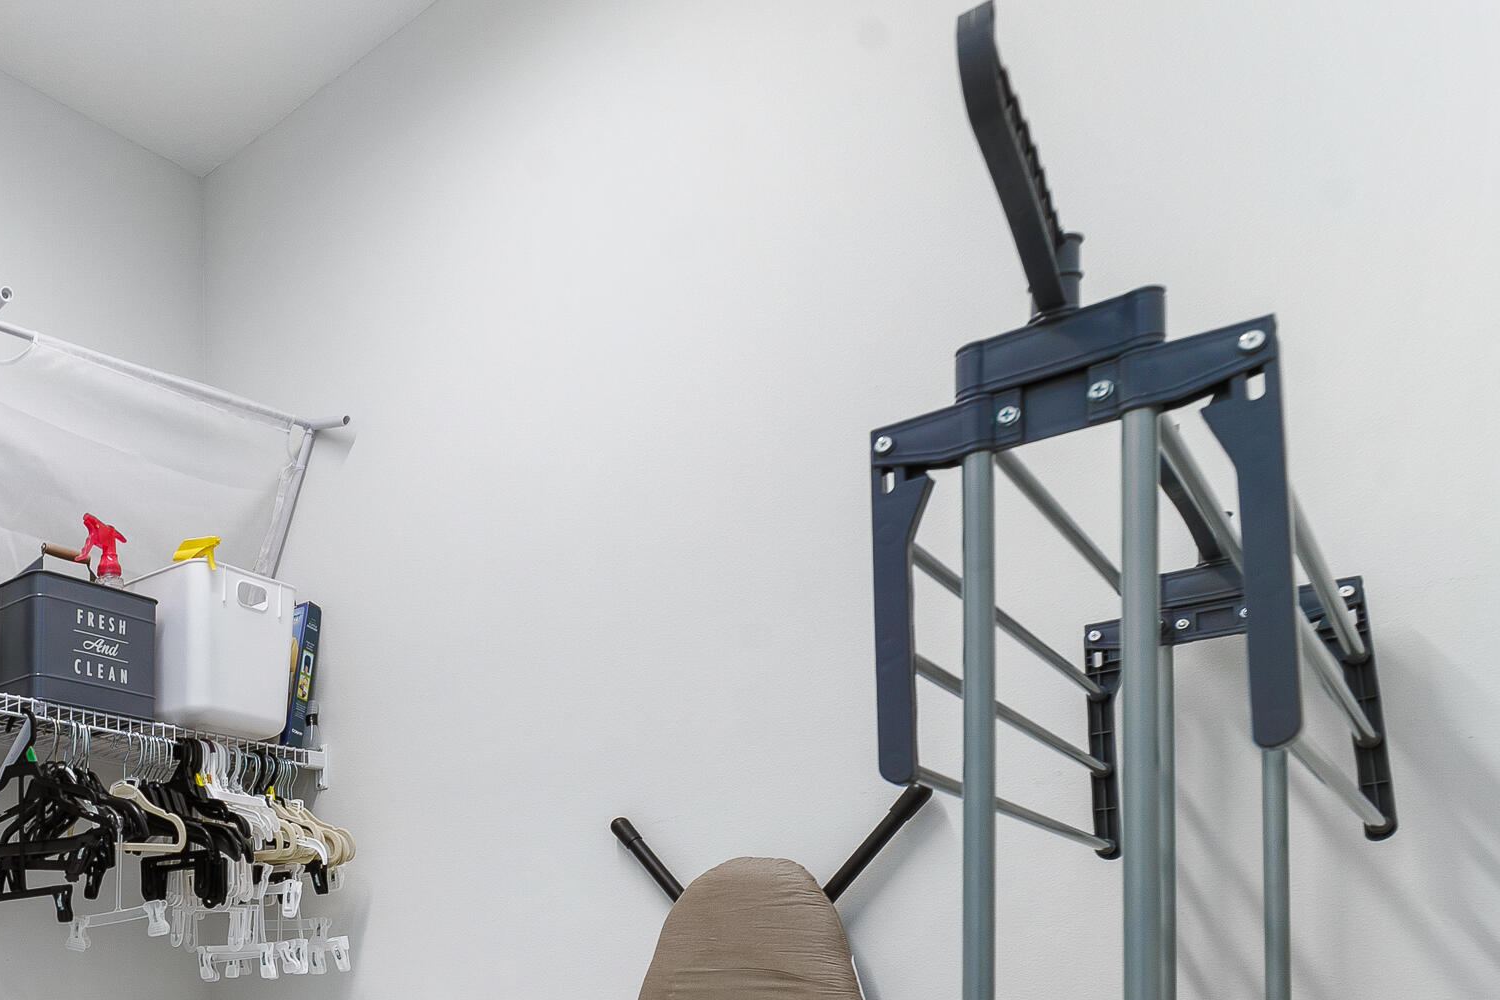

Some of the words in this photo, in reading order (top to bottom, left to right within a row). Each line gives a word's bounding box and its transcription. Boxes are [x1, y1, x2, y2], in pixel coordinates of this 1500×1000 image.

[76, 608, 126, 635] FRESH
[82, 638, 119, 657] And
[74, 658, 128, 684] CLEAN
